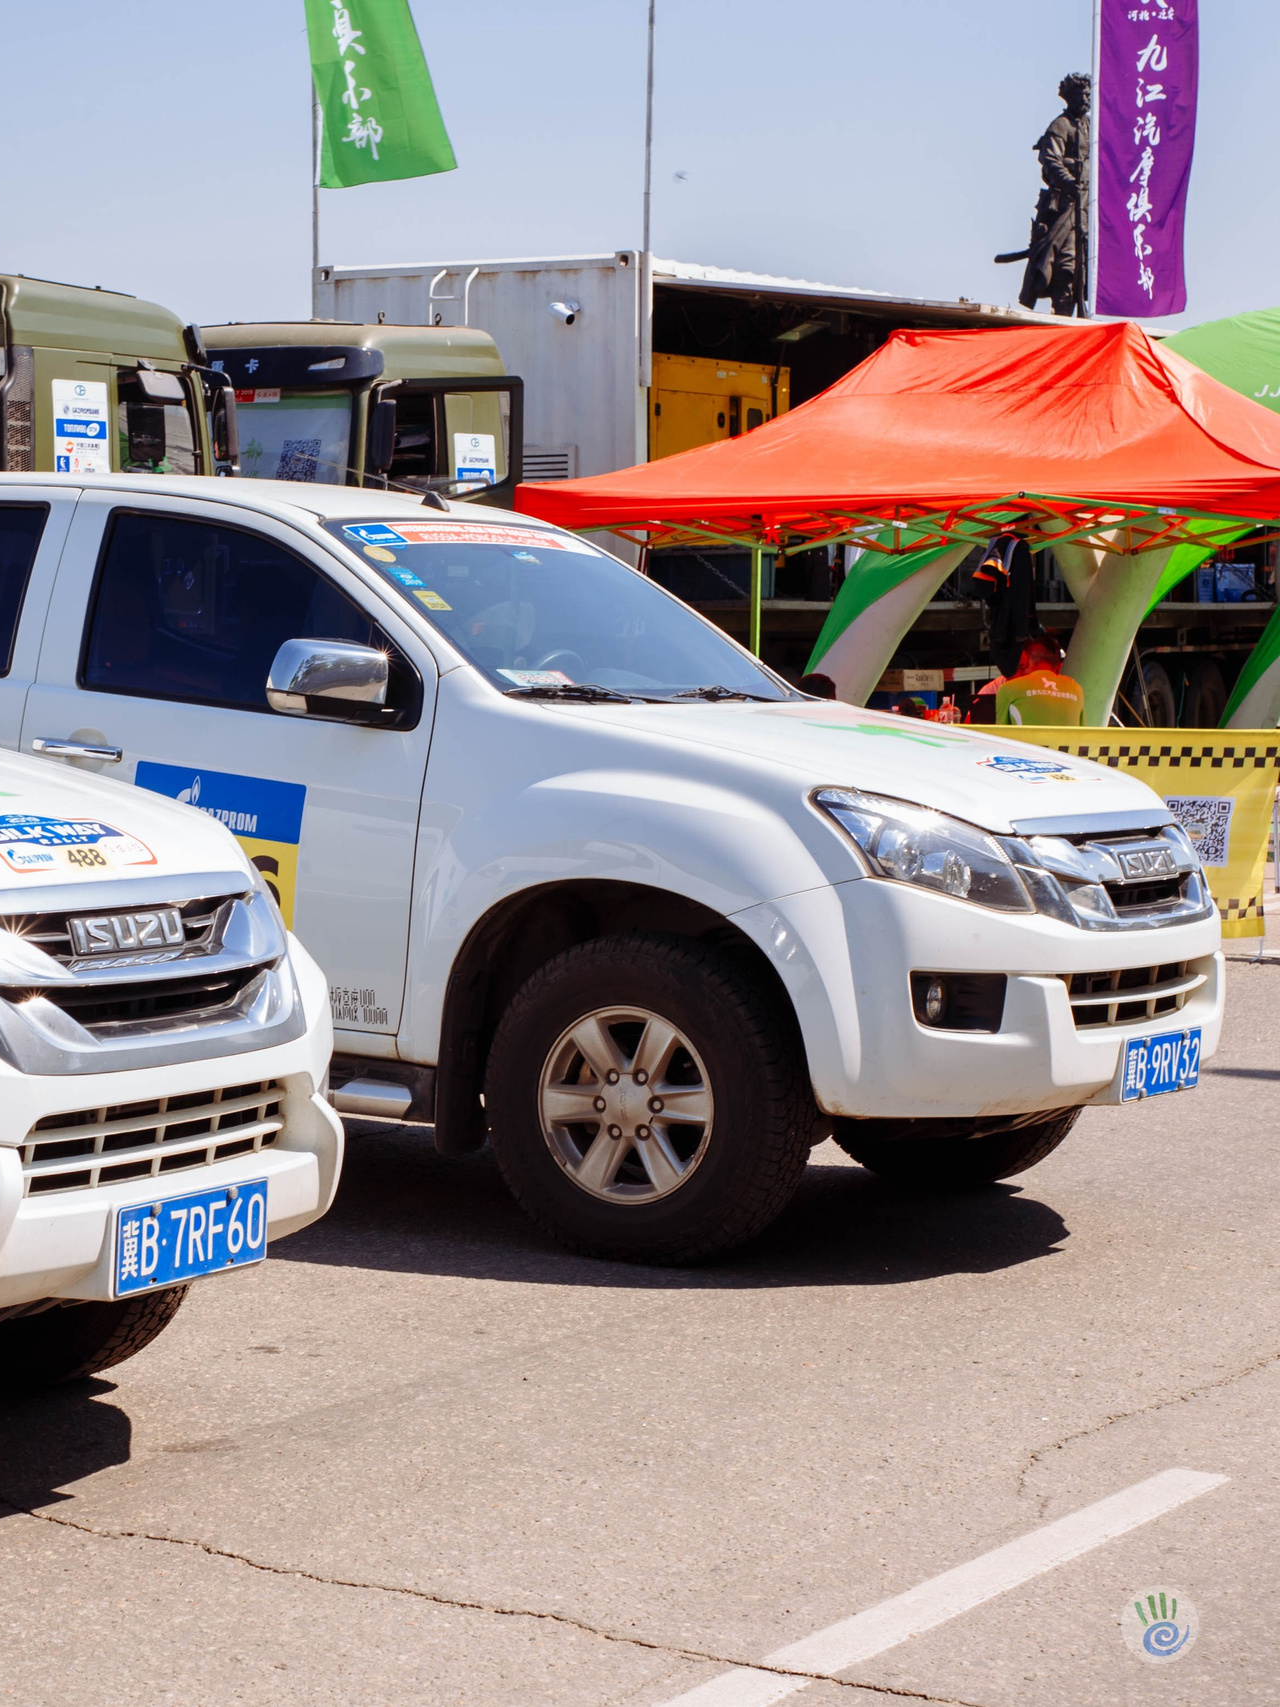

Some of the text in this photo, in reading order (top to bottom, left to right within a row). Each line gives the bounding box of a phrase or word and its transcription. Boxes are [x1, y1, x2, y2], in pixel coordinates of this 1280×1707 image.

[38, 836, 89, 845] RALLY
[44, 823, 107, 837] WAY
[67, 848, 107, 867] 488
[1120, 849, 1176, 877] ISUZU
[73, 911, 184, 954] ISUZU
[1126, 1037, 1200, 1090] 冀B·9RV32
[121, 1193, 266, 1281] 冀B·7RF60
